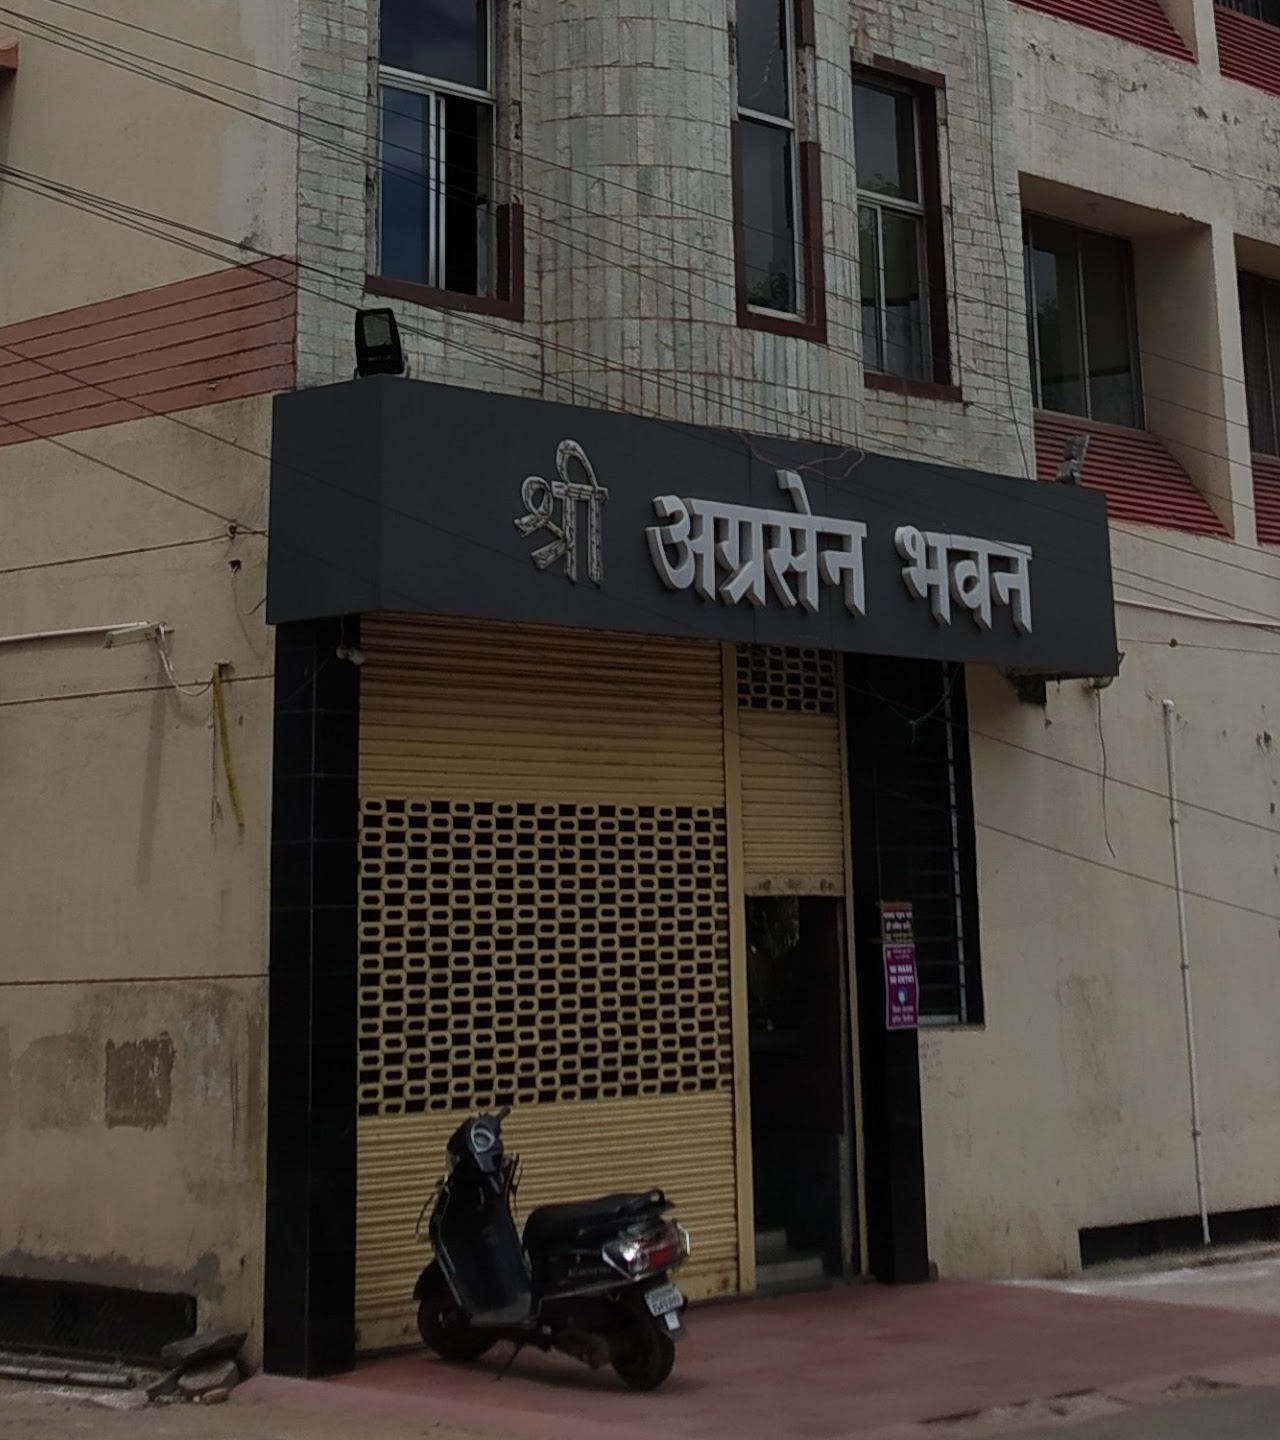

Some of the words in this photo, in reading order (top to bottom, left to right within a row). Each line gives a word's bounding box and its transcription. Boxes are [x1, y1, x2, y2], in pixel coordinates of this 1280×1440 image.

[514, 439, 609, 587] श्री
[646, 469, 868, 617] अग्रसेन
[895, 525, 1033, 634] भवन
